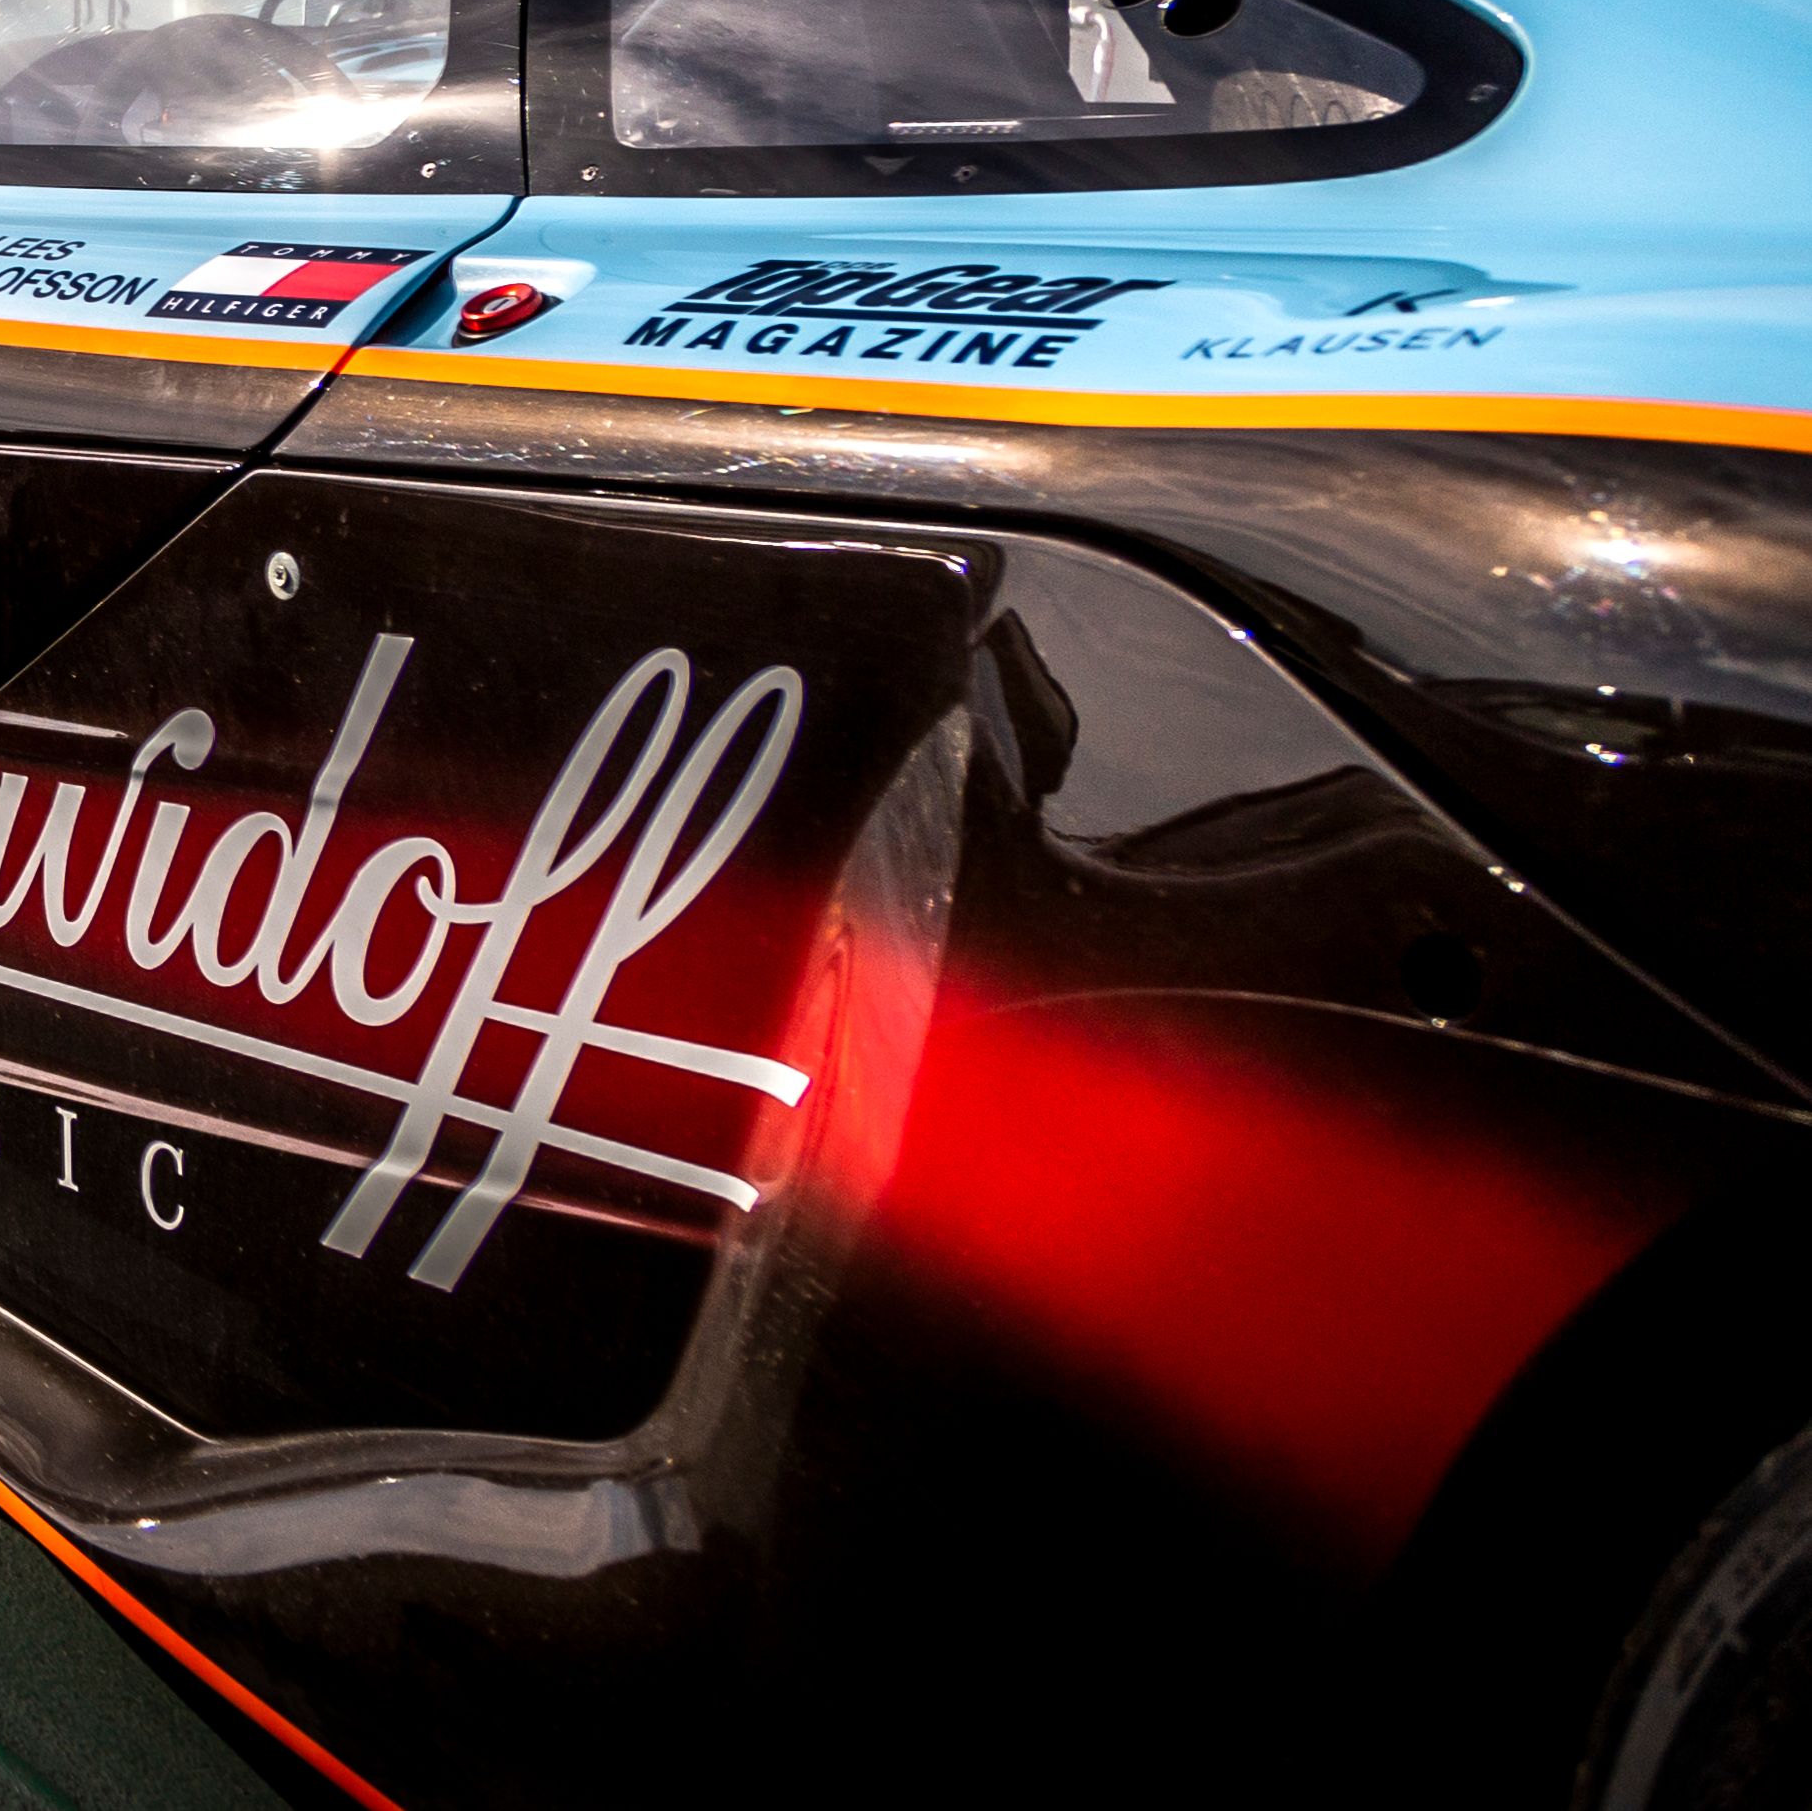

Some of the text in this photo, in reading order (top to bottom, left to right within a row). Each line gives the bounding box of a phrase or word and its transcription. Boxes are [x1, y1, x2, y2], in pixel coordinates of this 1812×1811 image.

[239, 244, 412, 262] TOMMY
[161, 297, 329, 320] HILFIGER
[623, 316, 1081, 369] MAGAZINE
[1180, 326, 1506, 360] KLAUSEN
